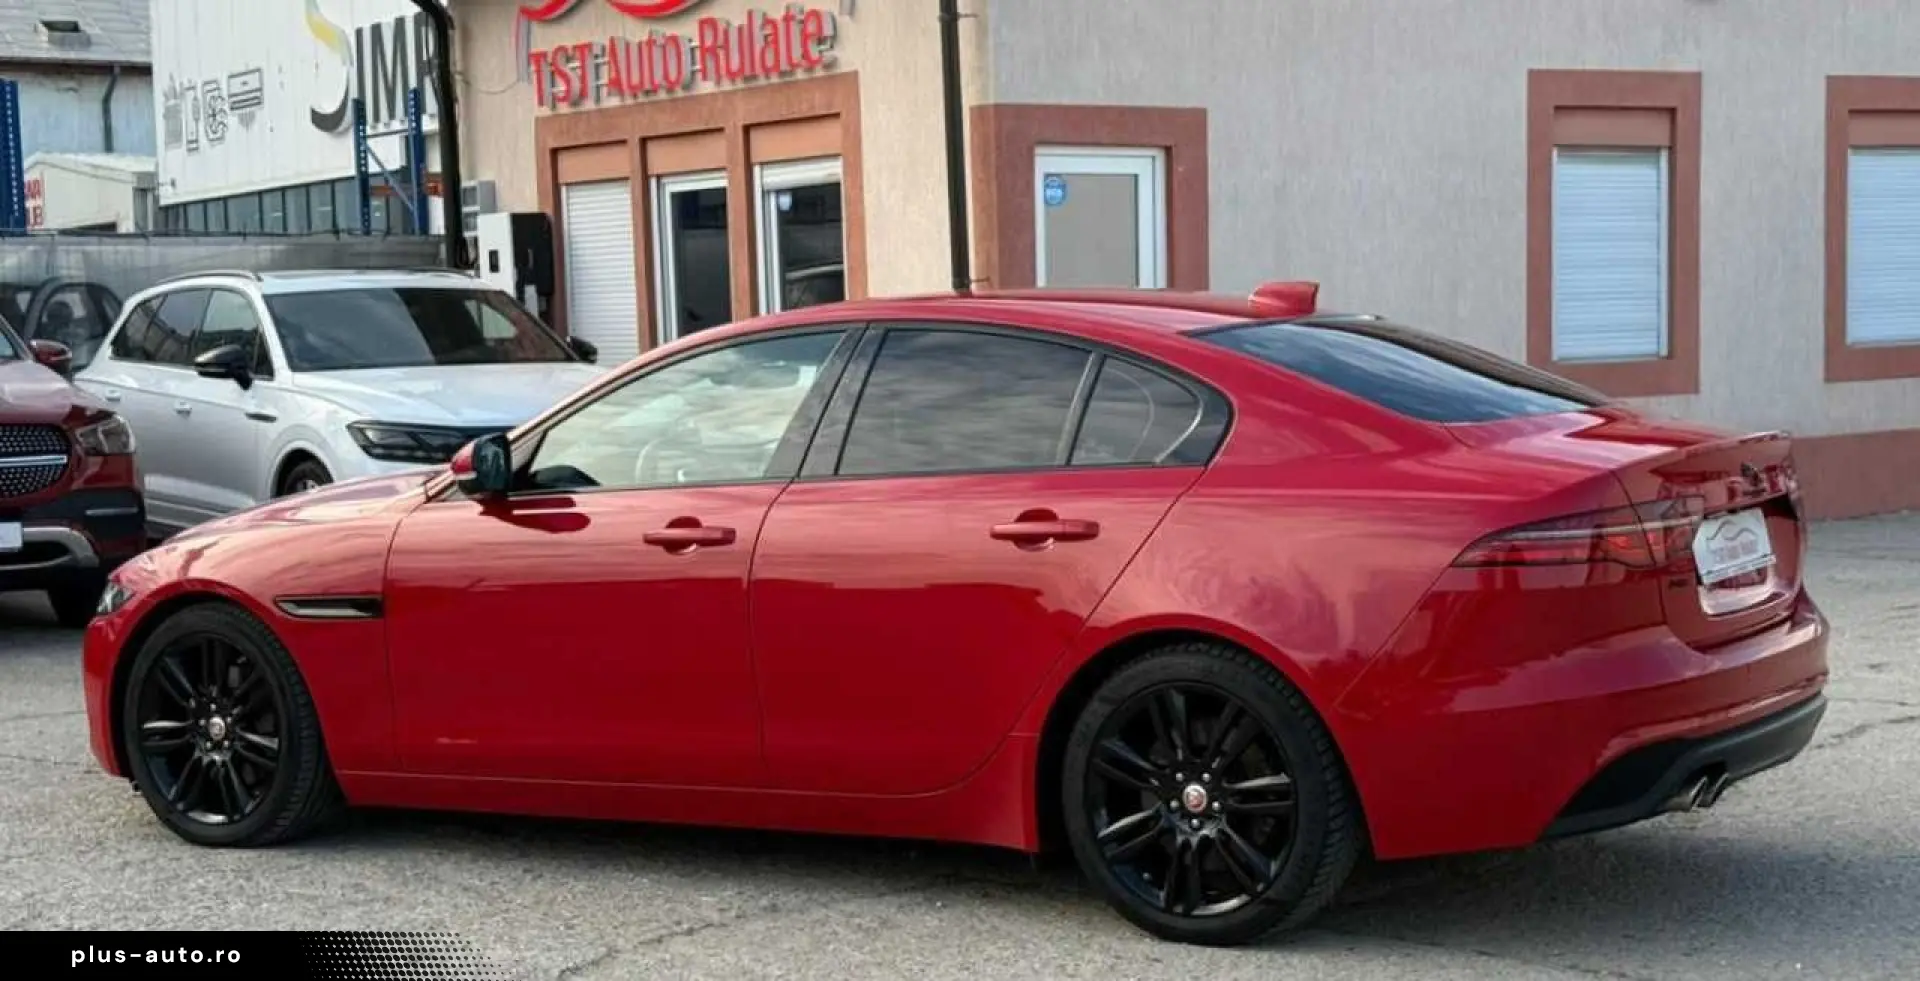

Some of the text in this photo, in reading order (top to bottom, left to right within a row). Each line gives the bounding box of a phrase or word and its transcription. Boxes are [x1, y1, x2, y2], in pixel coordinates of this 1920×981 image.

[528, 8, 823, 107] TST Auto Rulate
